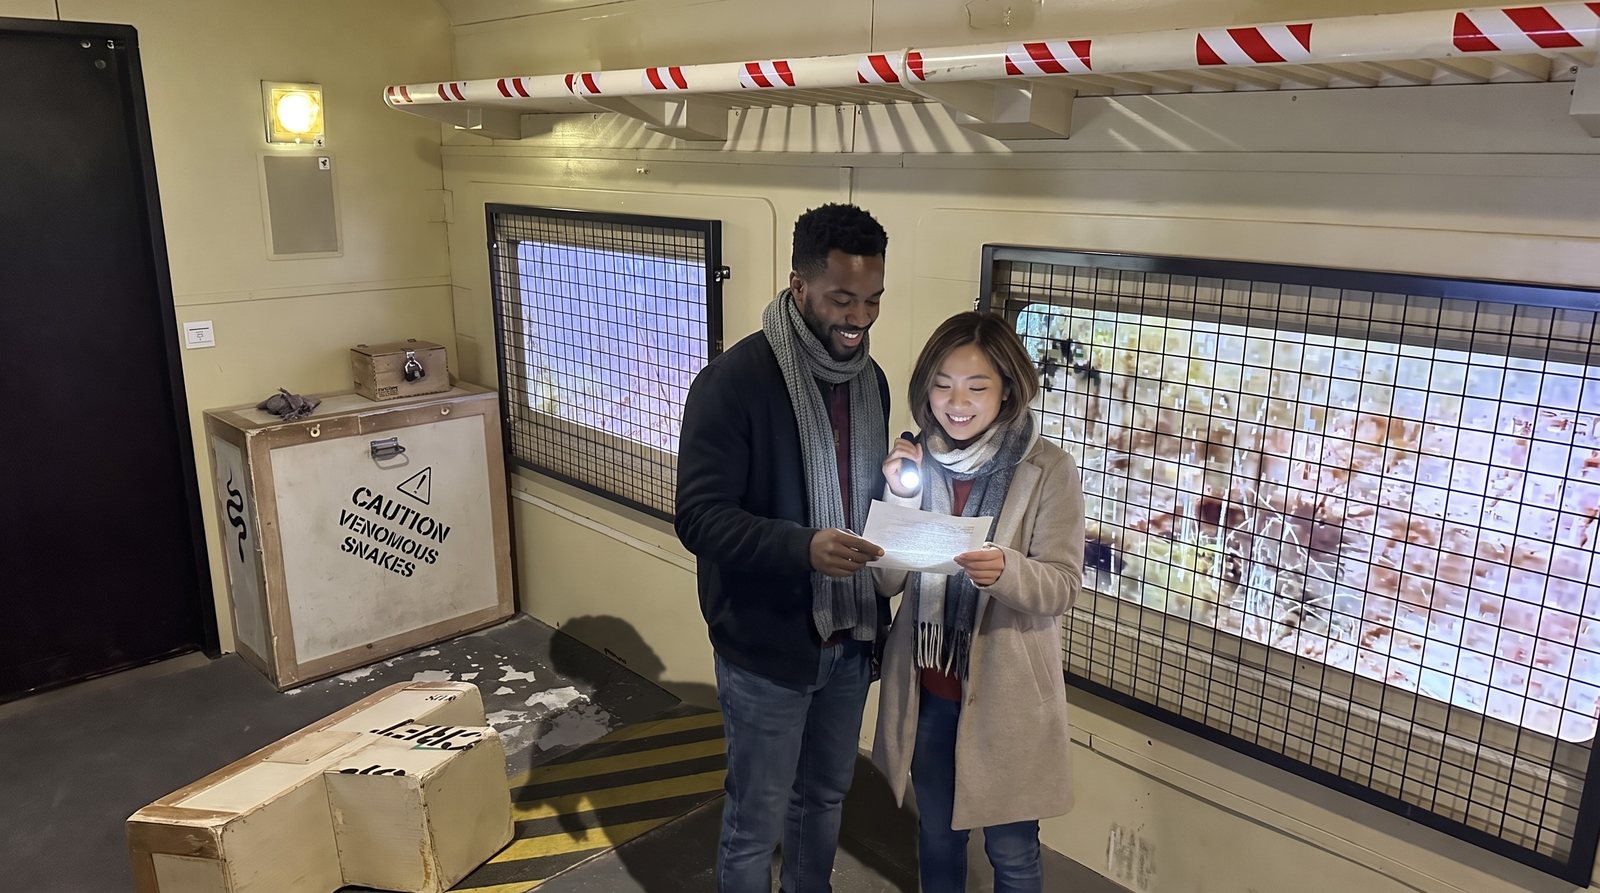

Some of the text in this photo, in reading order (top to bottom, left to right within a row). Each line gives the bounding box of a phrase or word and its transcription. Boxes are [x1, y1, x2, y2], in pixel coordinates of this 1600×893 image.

[339, 509, 439, 564] VENOMOUS
[352, 487, 450, 543] CAUTION
[341, 536, 416, 577] SNAKES
